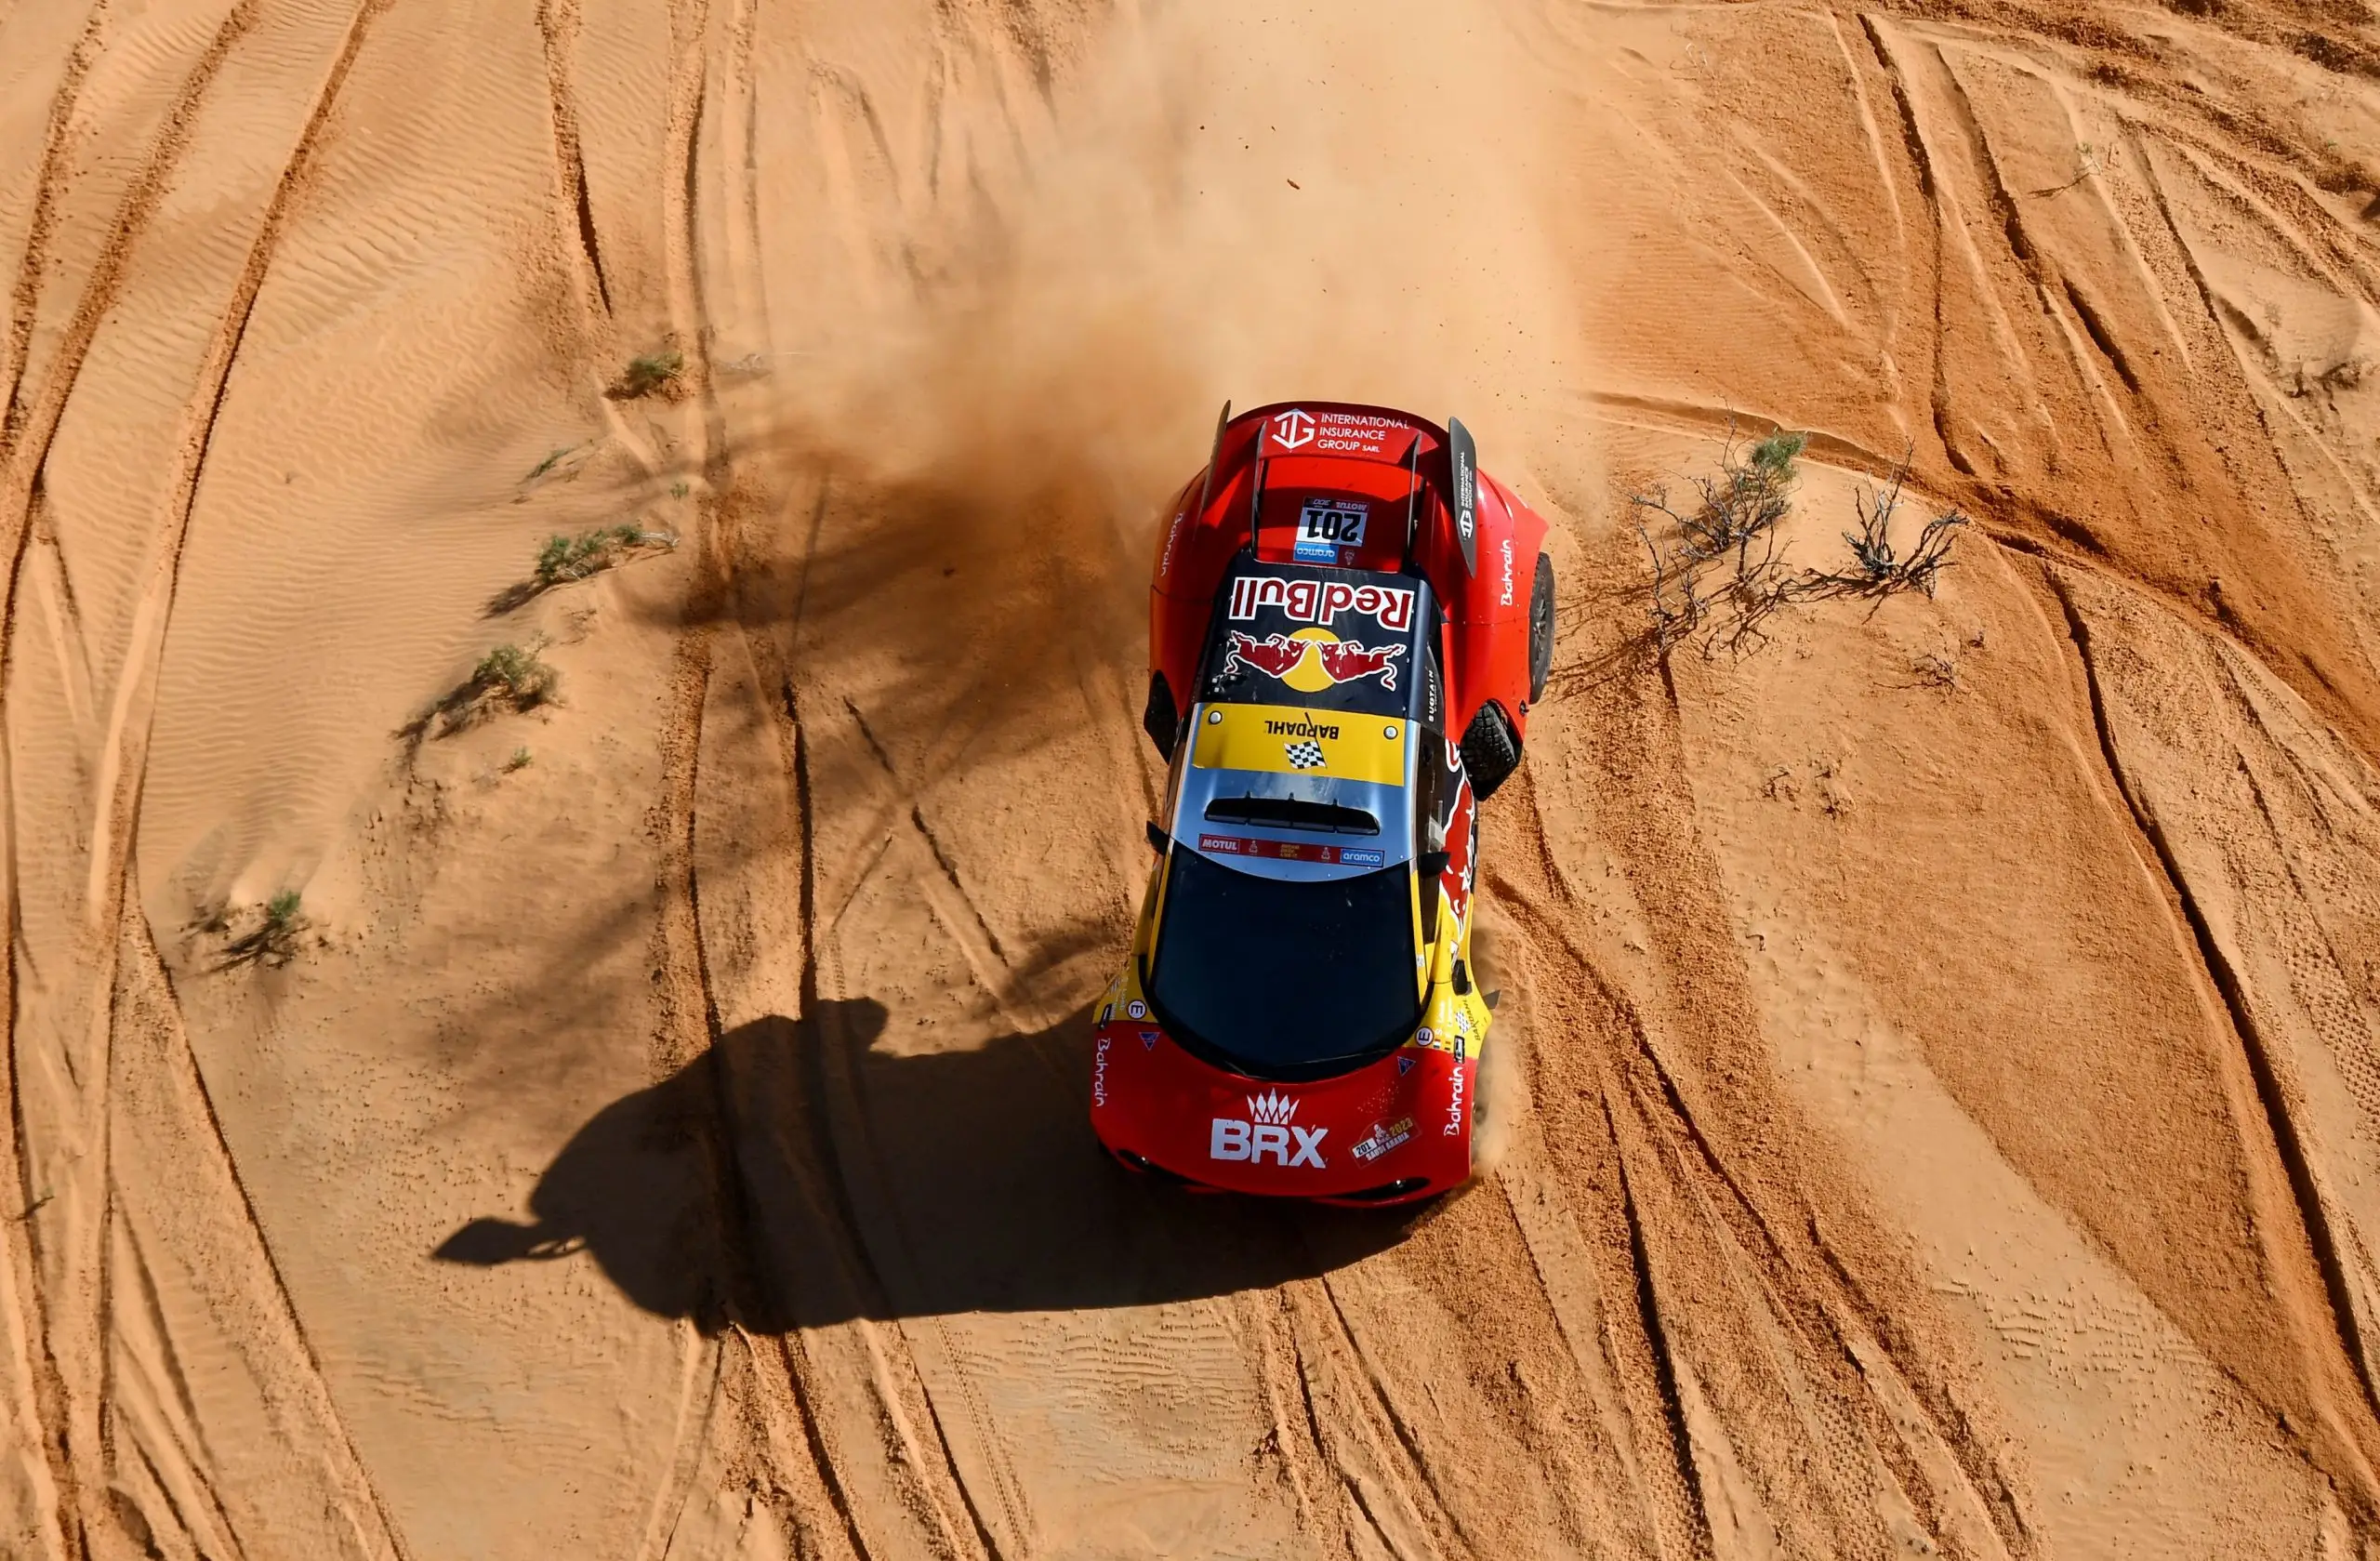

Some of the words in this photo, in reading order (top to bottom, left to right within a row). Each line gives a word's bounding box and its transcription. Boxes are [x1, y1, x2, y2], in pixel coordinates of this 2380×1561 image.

[1320, 413, 1409, 430] INTERNATIONAL
[1318, 426, 1385, 441] INSURANCE
[1317, 438, 1360, 452] GROUP
[1362, 444, 1381, 454] SARL
[1336, 501, 1368, 510] MOTUL
[1306, 509, 1361, 542] 201
[1160, 511, 1183, 576] Bahrain
[1296, 548, 1335, 558] aramco
[1501, 539, 1513, 607] Bahrain
[1228, 576, 1320, 628] Bull
[1318, 581, 1415, 632] Red
[1264, 721, 1340, 740] BARDAHL
[1201, 839, 1237, 851] MOTUL
[1342, 850, 1381, 863] aramco
[1094, 1038, 1111, 1107] Bahrain
[1444, 1066, 1463, 1137] Bahrain
[1389, 1118, 1413, 1137] 2023
[1210, 1118, 1329, 1169] BRX
[1356, 1142, 1371, 1156] 201
